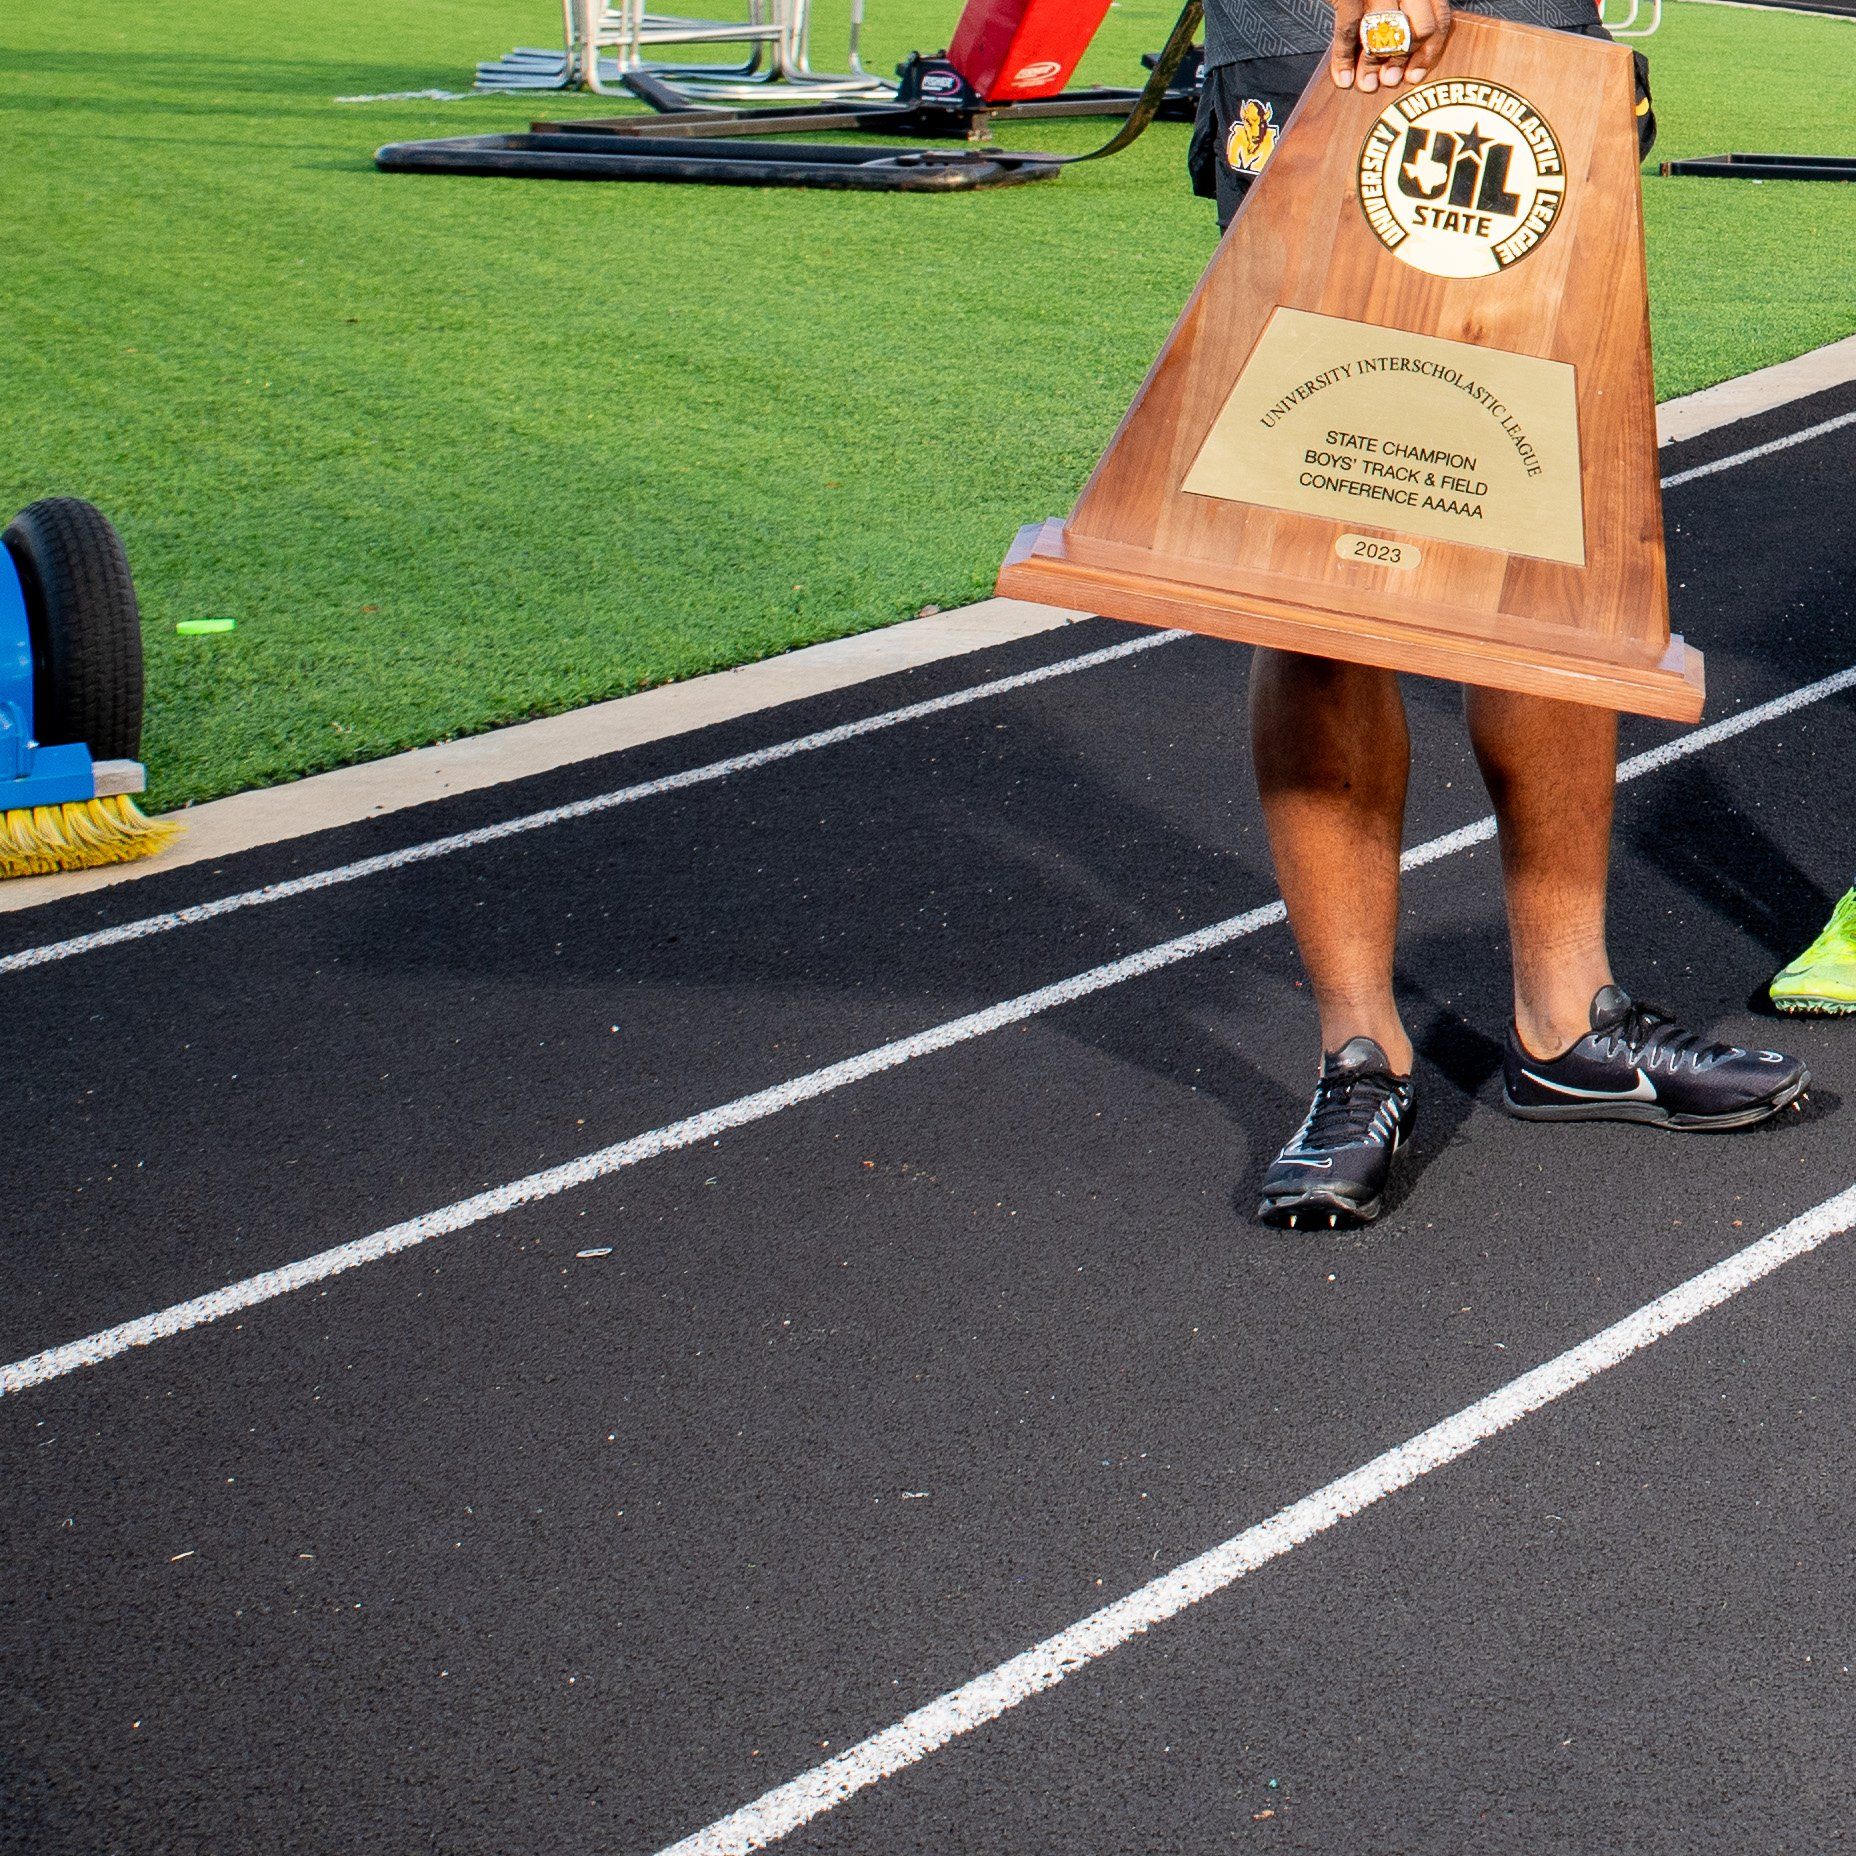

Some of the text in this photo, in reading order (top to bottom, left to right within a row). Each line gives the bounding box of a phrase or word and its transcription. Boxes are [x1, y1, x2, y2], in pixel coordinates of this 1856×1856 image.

[1360, 83, 1561, 265] UNIVERSITY INTERSCHOLASTIC LEAGUE
[1412, 205, 1493, 238] STATE
[1260, 357, 1543, 478] UNIVERSITY INTERSCHOLASTIC LEAGUE
[1304, 449, 1489, 497] BOYS' TRACK & FIELD
[1326, 430, 1478, 472] STATE CHAMPION
[1299, 471, 1484, 520] CONFERENCE AAAAA
[1353, 540, 1402, 564] 2023
